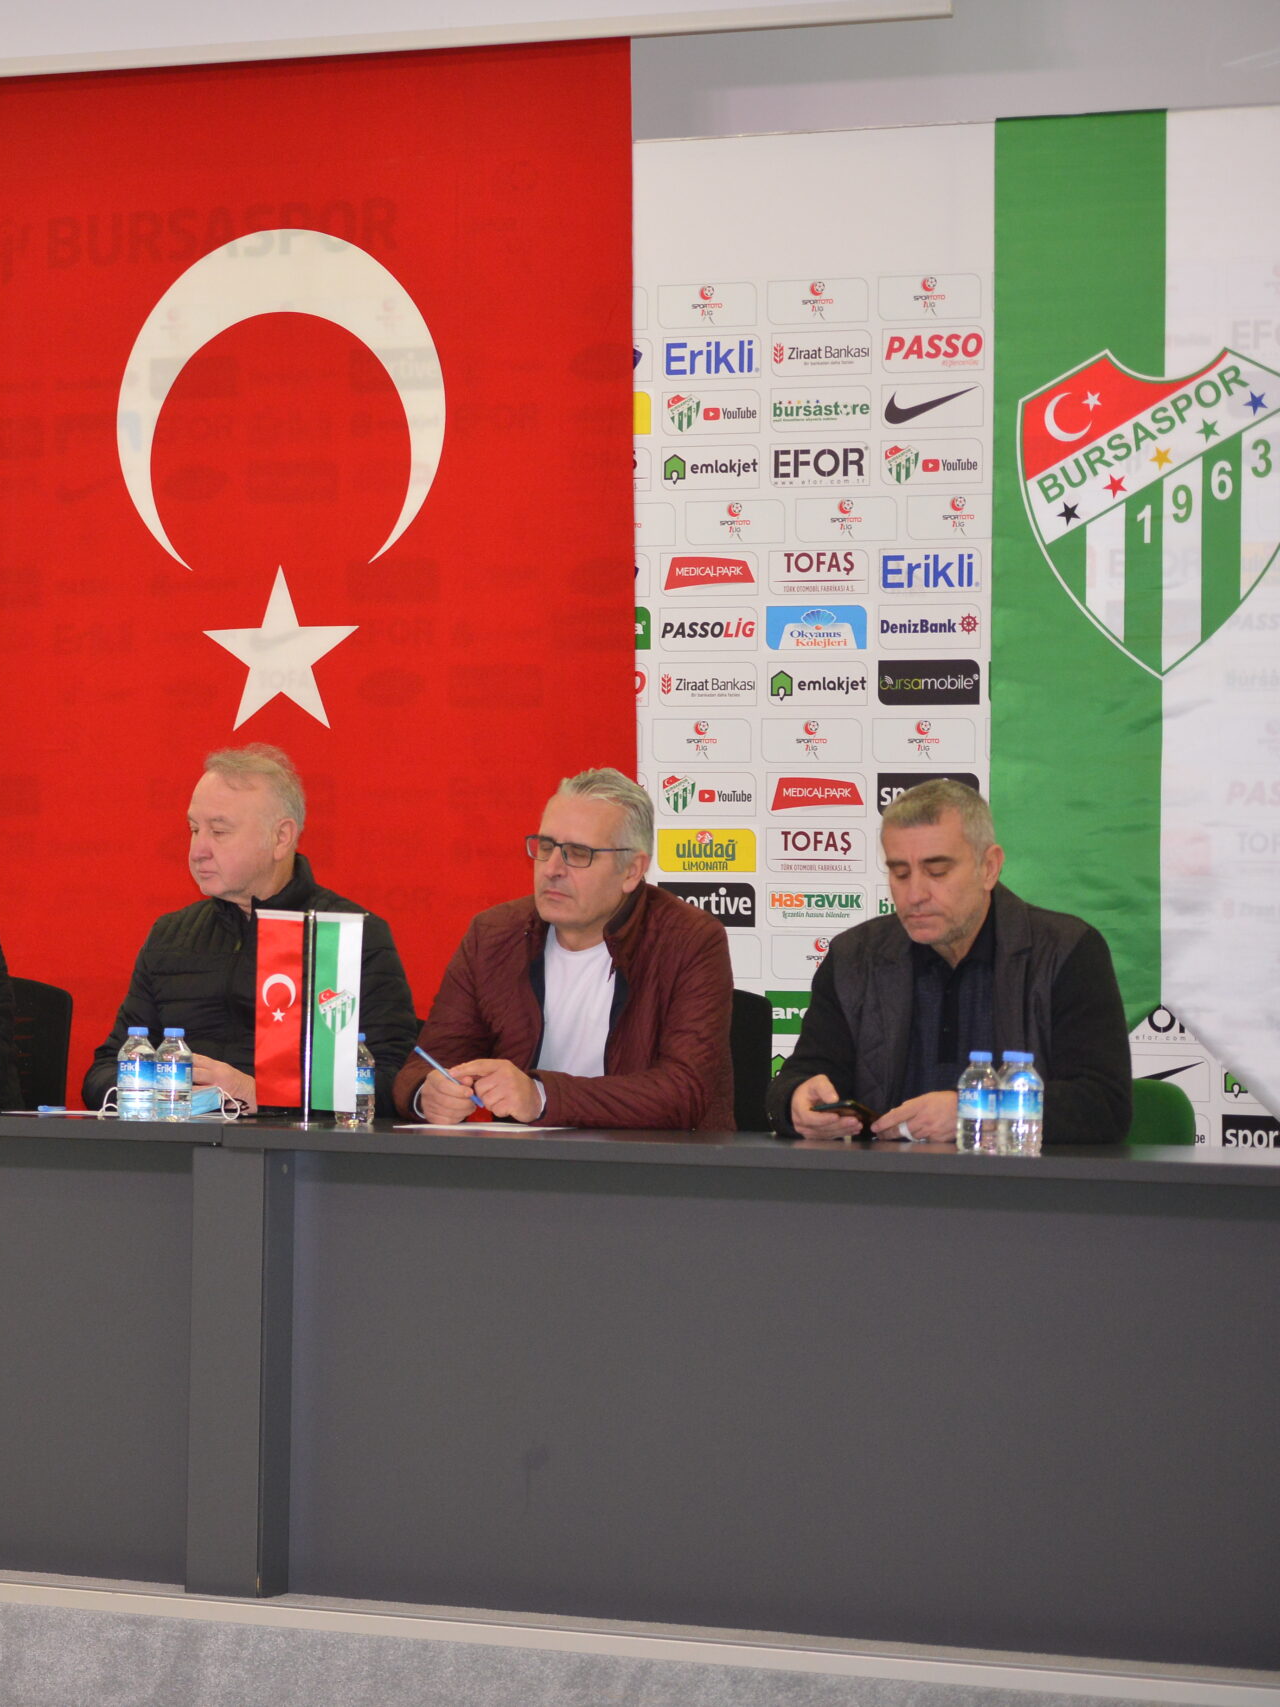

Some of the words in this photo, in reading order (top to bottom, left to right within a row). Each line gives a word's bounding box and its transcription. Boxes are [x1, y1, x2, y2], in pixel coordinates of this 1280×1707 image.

[45, 197, 399, 271] BURSASPOR
[787, 346, 822, 360] Ziraat
[824, 345, 870, 359] Bankası
[885, 333, 983, 360] PASSO
[665, 340, 753, 376] Erikli
[722, 407, 757, 419] YouTube
[1036, 365, 1250, 504] BURSASPOR
[690, 458, 758, 477] emlakjet
[773, 448, 865, 478] EFOR
[942, 459, 978, 471] YouTube
[784, 551, 855, 575] TOFAŞ
[882, 554, 973, 588] Erikli
[790, 630, 842, 639] Okyanus
[880, 619, 957, 633] DenizBank
[795, 639, 848, 648] Kolejleri
[675, 678, 710, 691] Ziraat
[712, 678, 755, 690] Bankası
[797, 676, 867, 695] emlakjet
[717, 790, 752, 802] YouTube
[676, 840, 736, 861] uludağ
[781, 831, 852, 855] TOFAŞ
[677, 887, 752, 915] ortive
